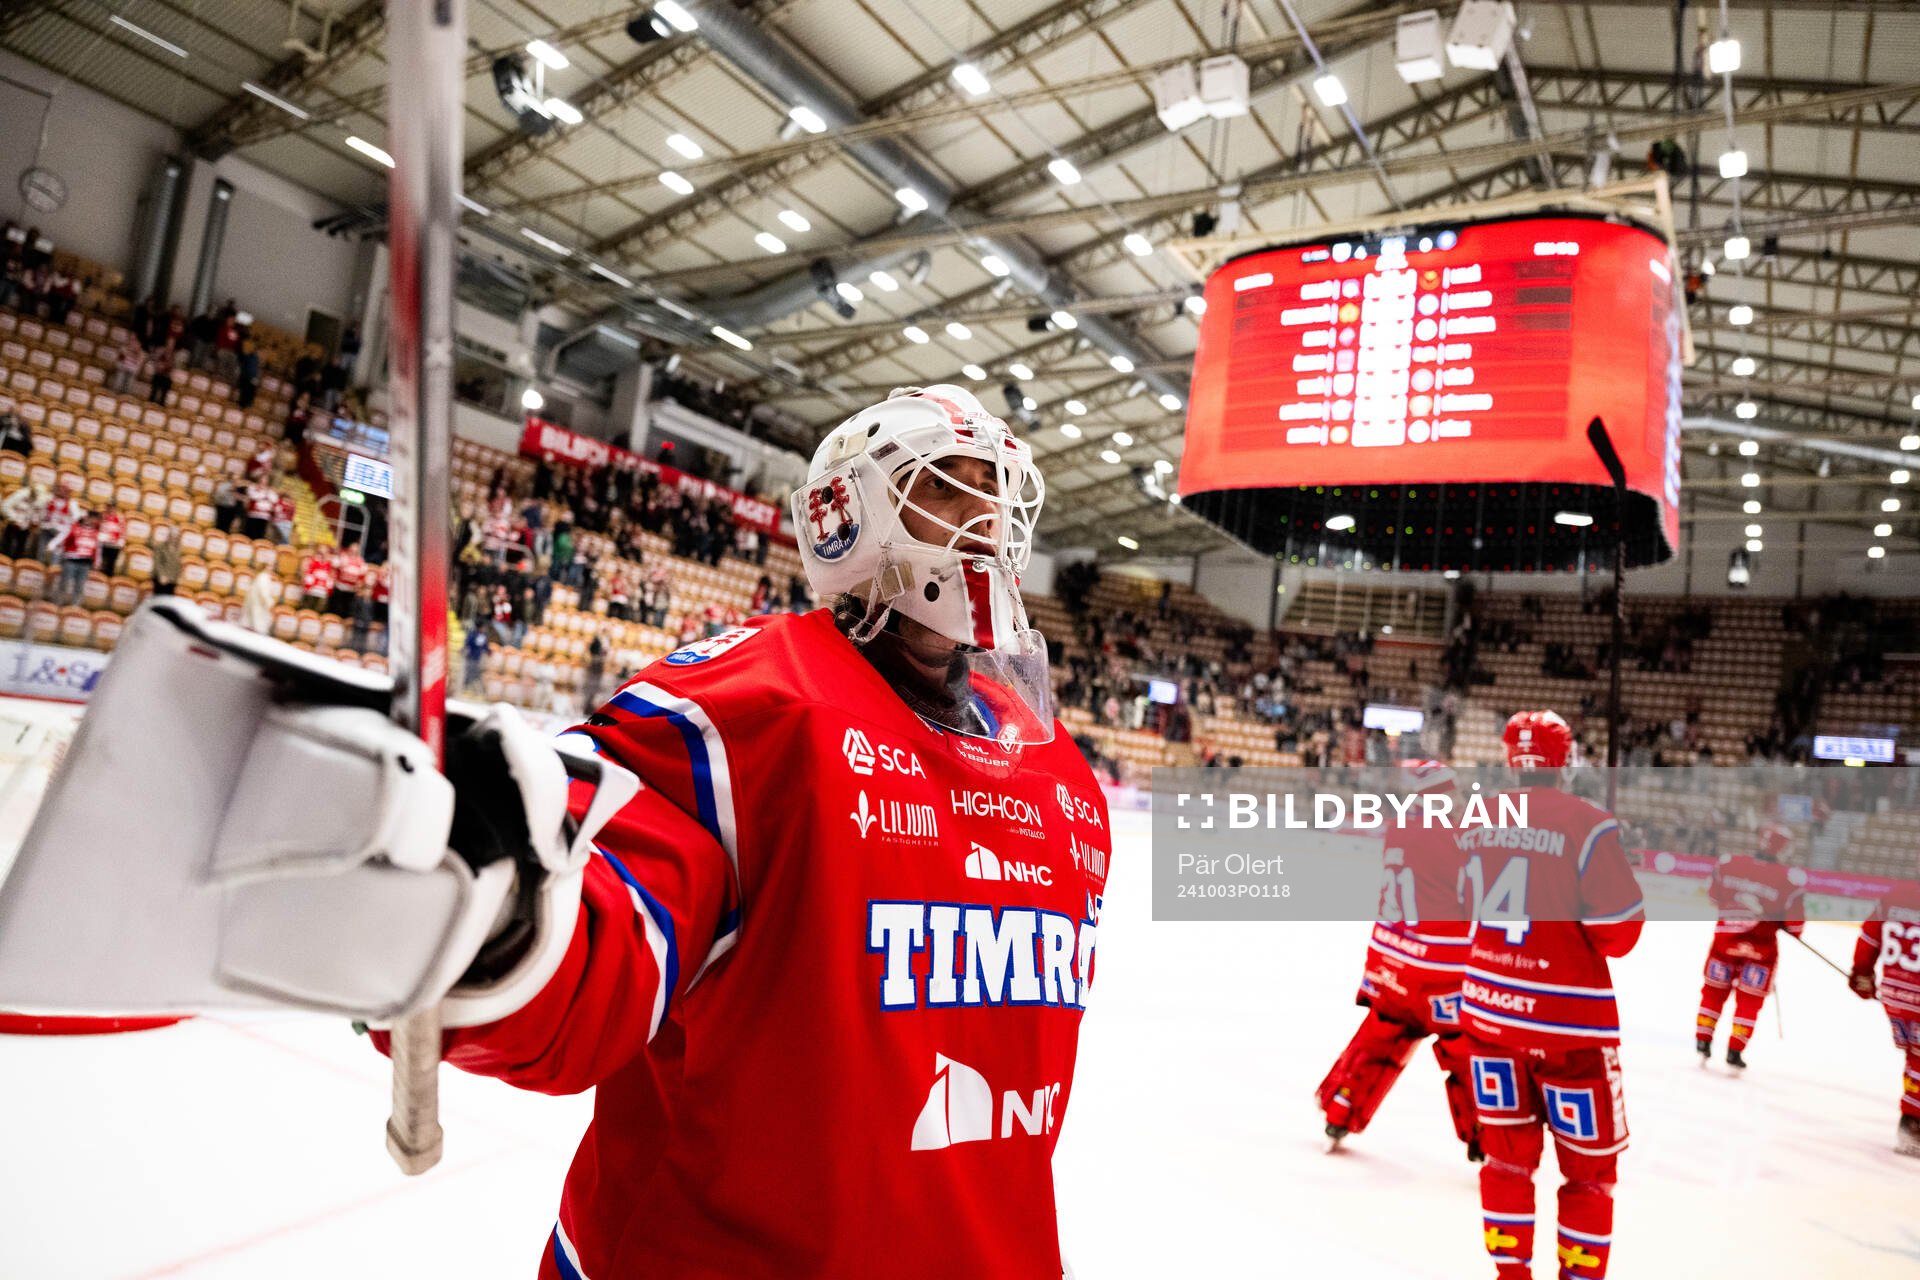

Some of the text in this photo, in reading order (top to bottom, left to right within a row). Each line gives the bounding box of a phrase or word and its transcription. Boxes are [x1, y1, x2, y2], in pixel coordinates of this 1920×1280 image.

[878, 744, 927, 780] SCA
[880, 798, 938, 838] LILIUM
[950, 788, 1043, 828] HIGHCON
[1074, 796, 1104, 830] SCA
[1003, 860, 1053, 887] NHC
[1464, 853, 1531, 946] 14
[1881, 920, 1920, 973] 63
